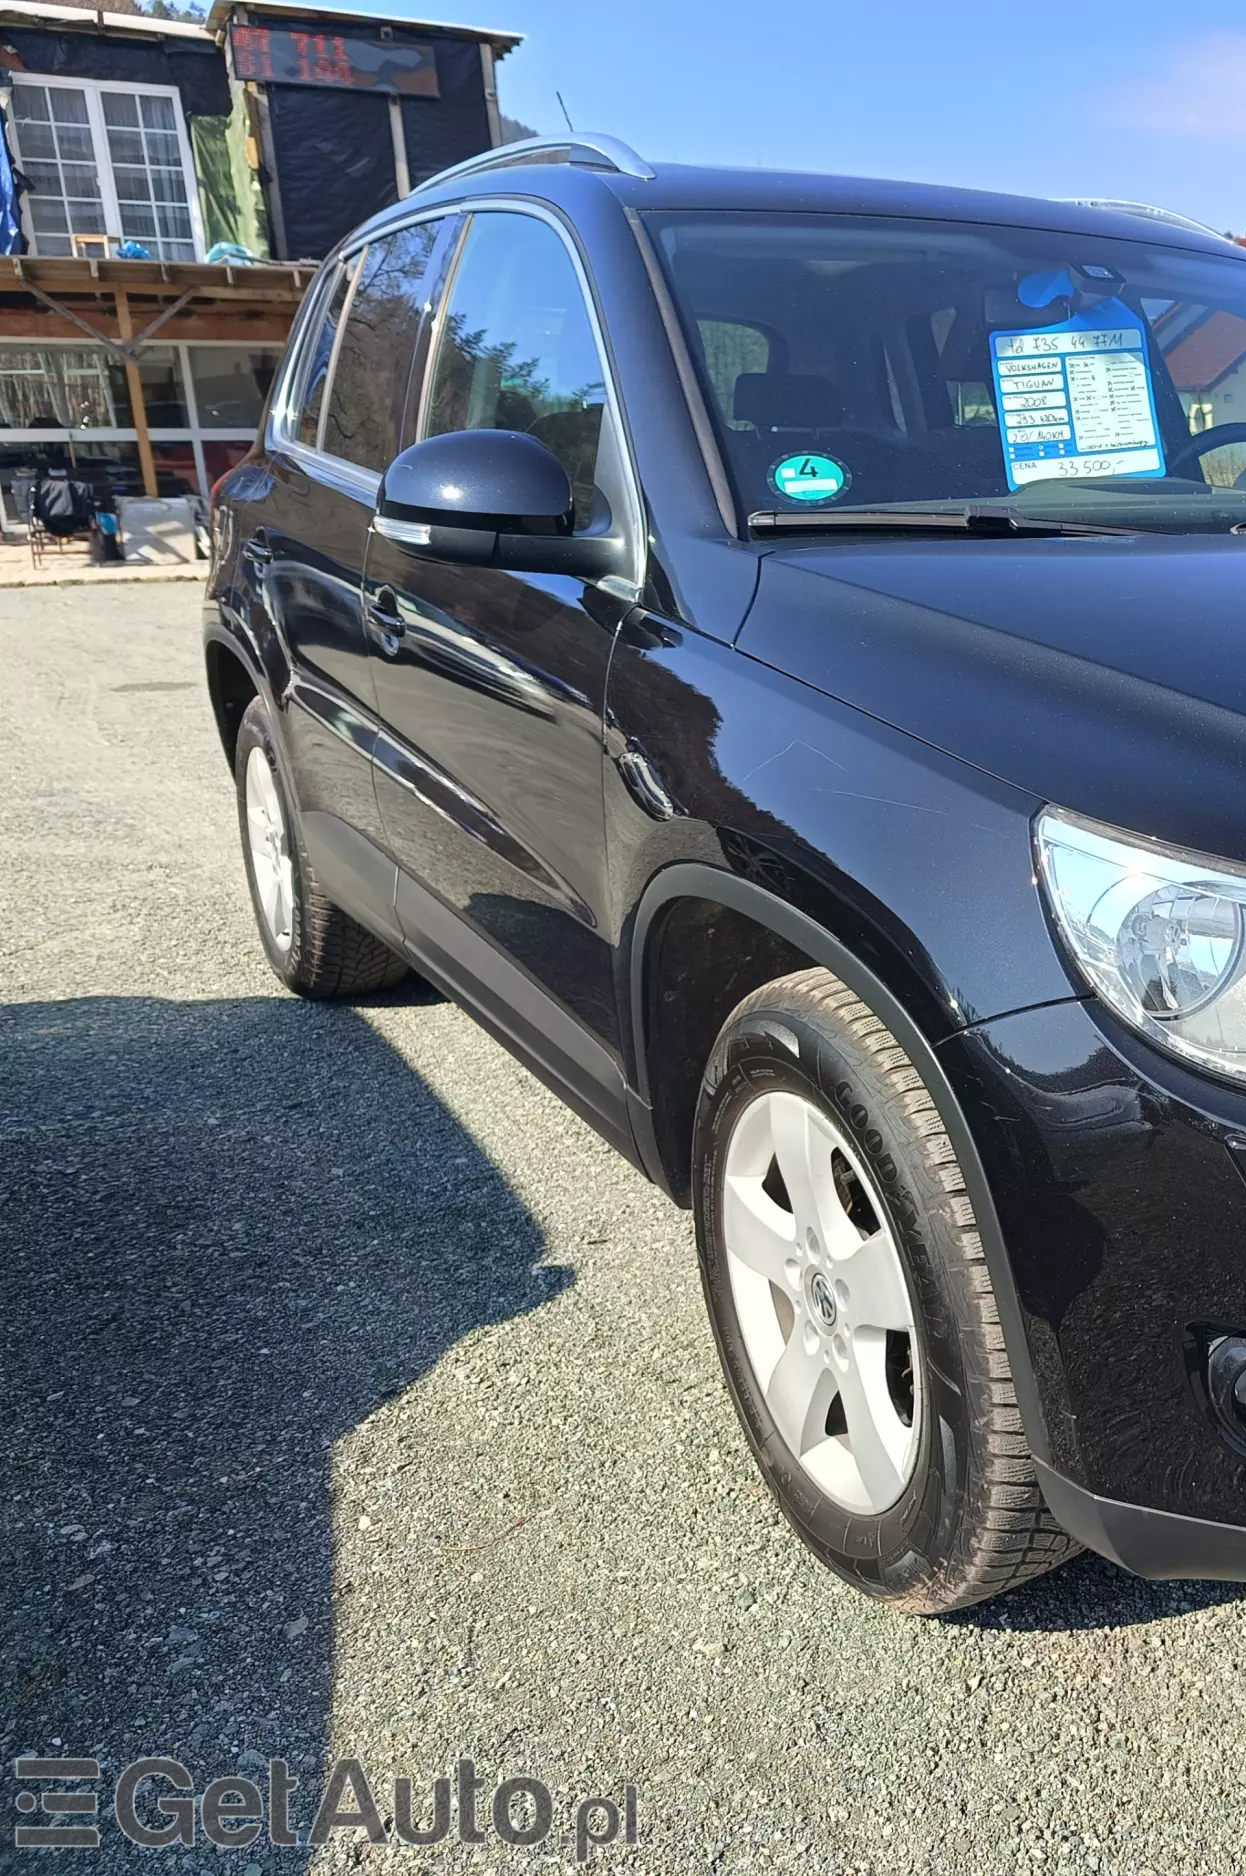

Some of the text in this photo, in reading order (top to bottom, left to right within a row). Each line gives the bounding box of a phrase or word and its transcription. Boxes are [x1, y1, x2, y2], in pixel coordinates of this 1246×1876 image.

[1033, 336, 1059, 352] 735
[1071, 335, 1085, 349] 44
[1013, 377, 1054, 390] TIGUAN
[1020, 395, 1047, 409] 2008
[799, 457, 819, 478] 4
[1013, 462, 1037, 471] CENA
